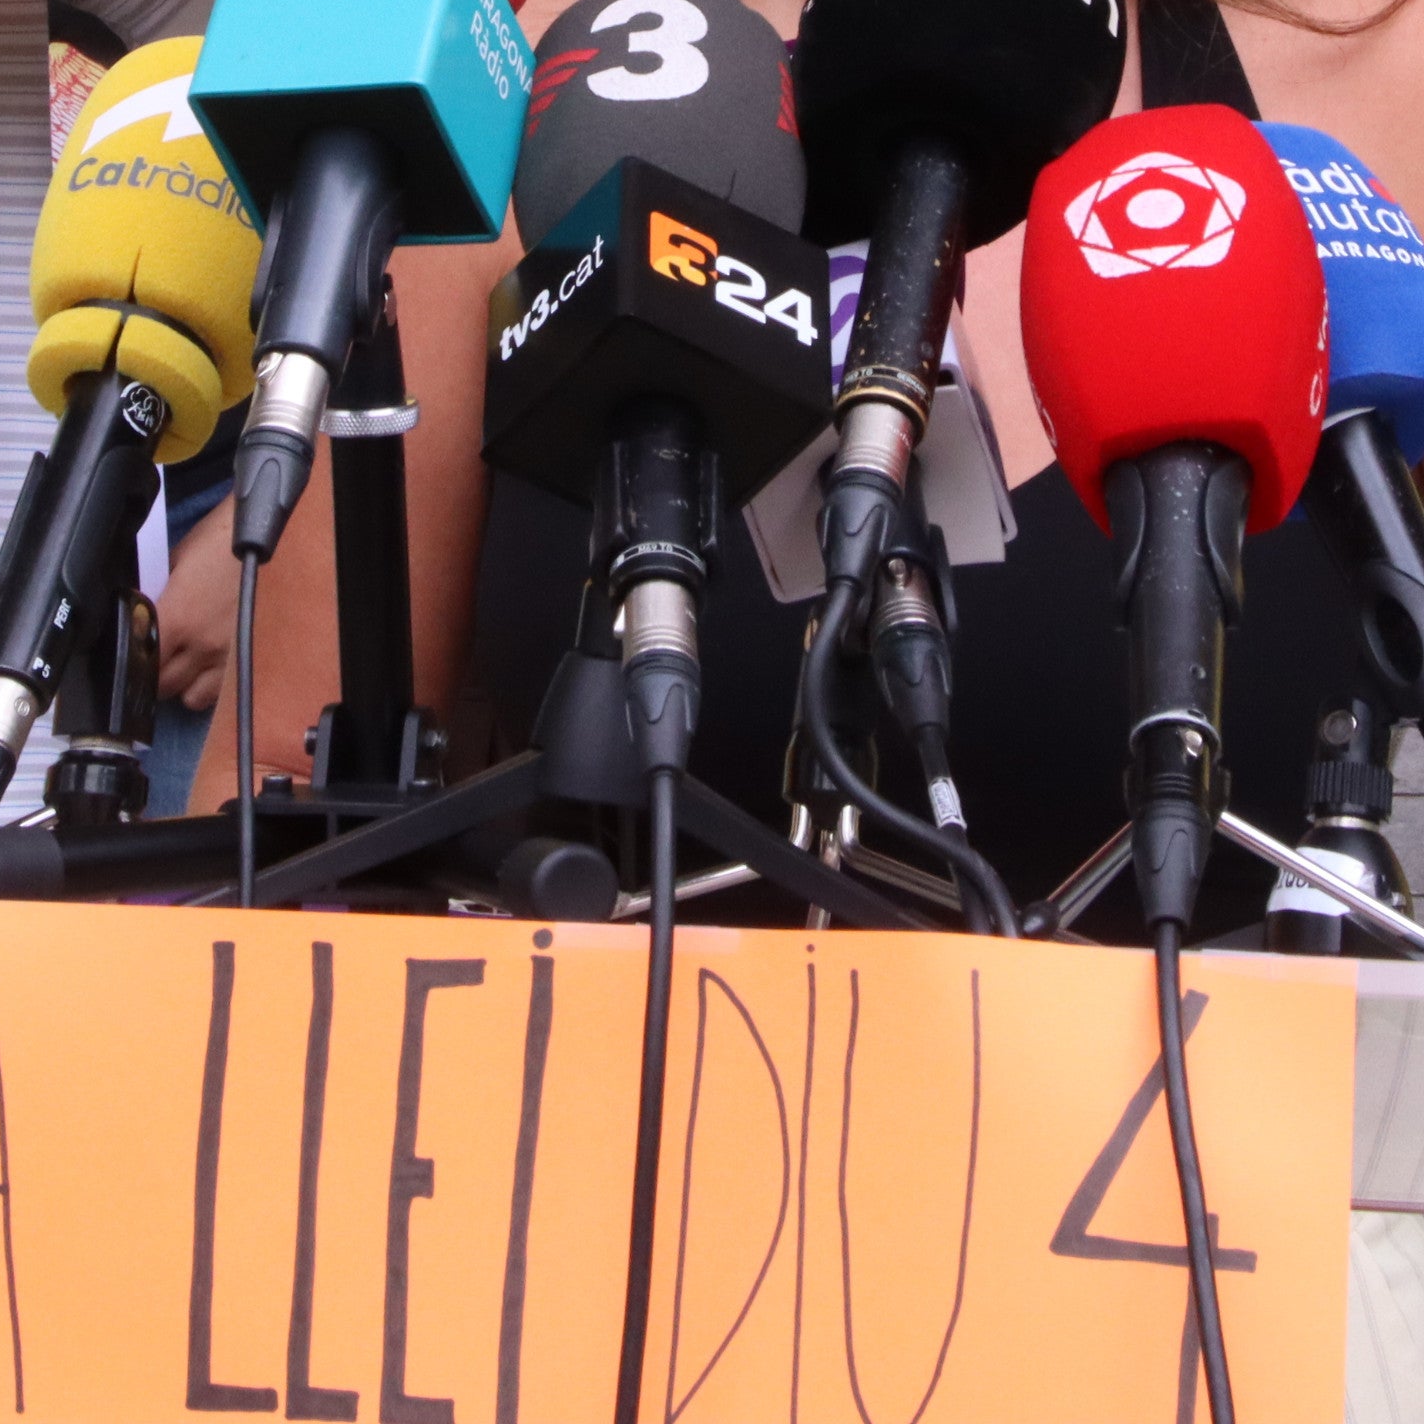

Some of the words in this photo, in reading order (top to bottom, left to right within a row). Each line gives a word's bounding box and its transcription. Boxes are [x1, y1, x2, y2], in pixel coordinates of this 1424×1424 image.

[470, 10, 509, 100] Ràdio
[1303, 197, 1424, 246] iutat
[499, 234, 604, 361] tv3.cat
[184, 928, 556, 1424] LLEI
[665, 943, 983, 1424] DIU
